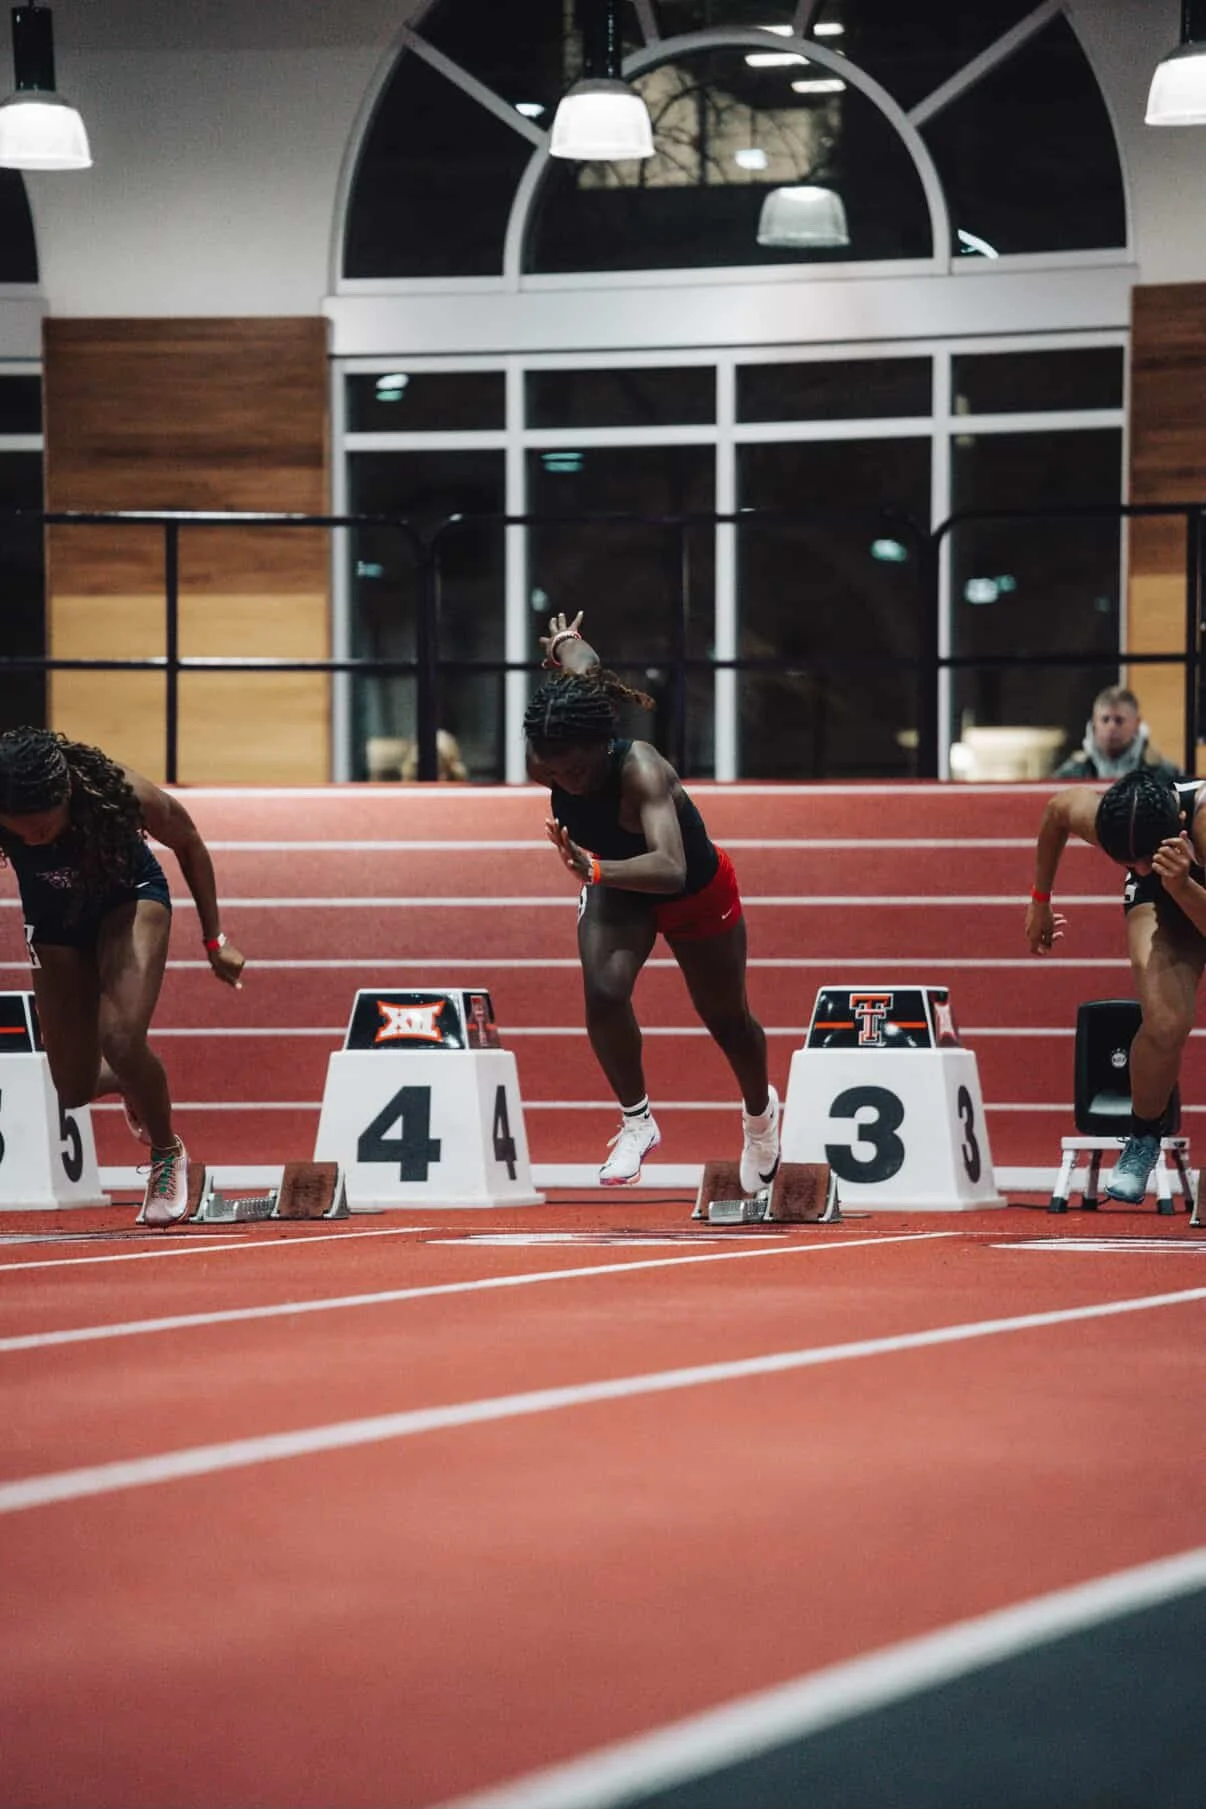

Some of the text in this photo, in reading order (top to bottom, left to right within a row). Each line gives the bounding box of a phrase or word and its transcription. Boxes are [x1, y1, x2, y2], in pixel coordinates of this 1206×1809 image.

[58, 1107, 84, 1183] 5
[357, 1085, 441, 1182] 4
[492, 1085, 517, 1181] 4
[824, 1085, 905, 1184] 3
[957, 1084, 981, 1184] 3
